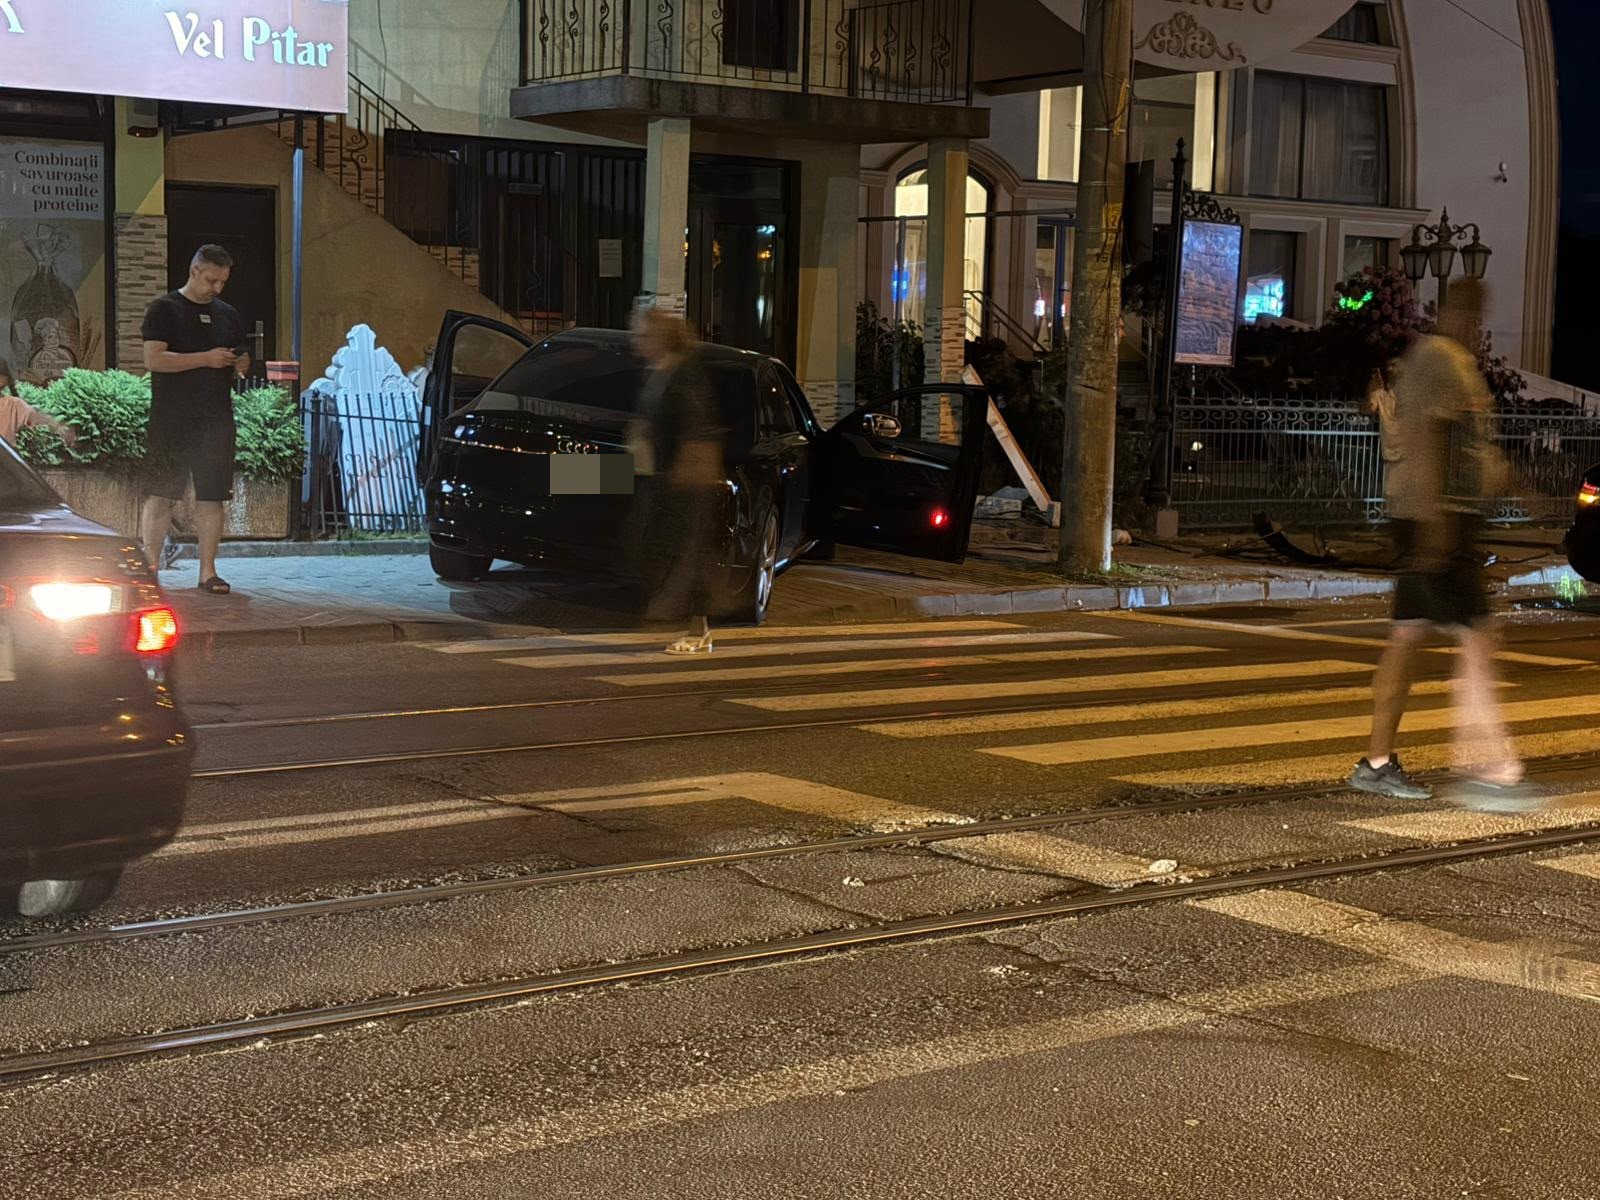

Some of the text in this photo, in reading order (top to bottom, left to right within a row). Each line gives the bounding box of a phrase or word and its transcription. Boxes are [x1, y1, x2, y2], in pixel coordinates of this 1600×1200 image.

[164, 11, 336, 68] Vel Pitar
[15, 150, 98, 171] Combinații
[20, 168, 98, 182] savuroase
[32, 183, 98, 197] cu multe
[34, 199, 99, 213] proteine
